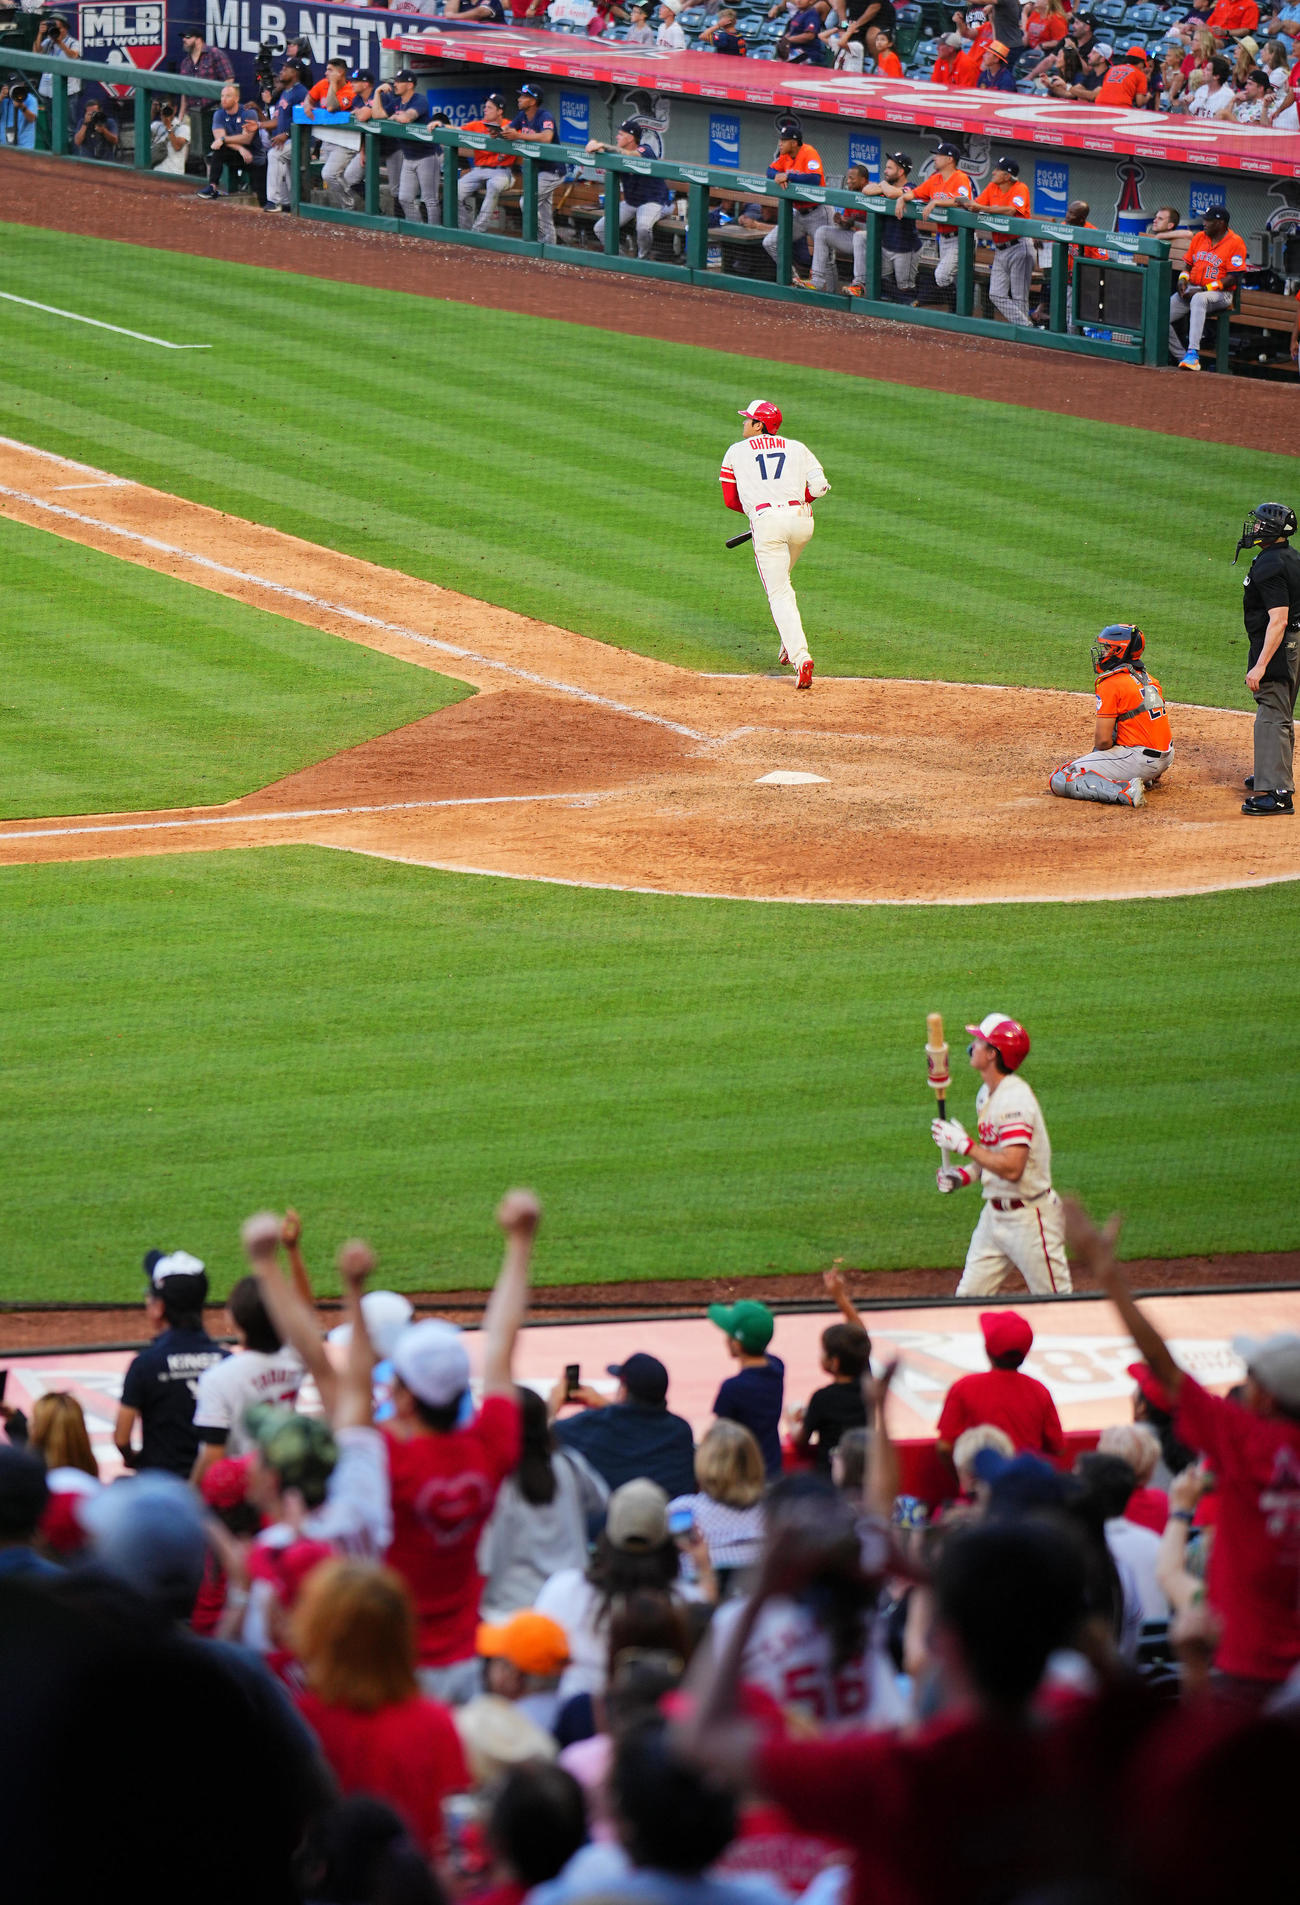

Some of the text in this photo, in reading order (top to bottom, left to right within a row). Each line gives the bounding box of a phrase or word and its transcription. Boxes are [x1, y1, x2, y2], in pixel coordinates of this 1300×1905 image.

[83, 5, 162, 38] MLB
[206, 0, 288, 56] MLB
[84, 36, 161, 48] NETWORK
[561, 101, 587, 112] POCARI
[561, 108, 585, 118] SWEAT
[711, 122, 739, 134] POCARI
[711, 129, 736, 140] SWEAT
[850, 142, 878, 154] POCARI
[850, 150, 876, 161] SWEAT
[1036, 169, 1067, 181] POCARI
[1036, 177, 1064, 188] SWEAT
[1191, 191, 1223, 203] POCARI
[1205, 265, 1219, 280] 12
[749, 437, 786, 450] OHTANI
[755, 452, 786, 480] 17
